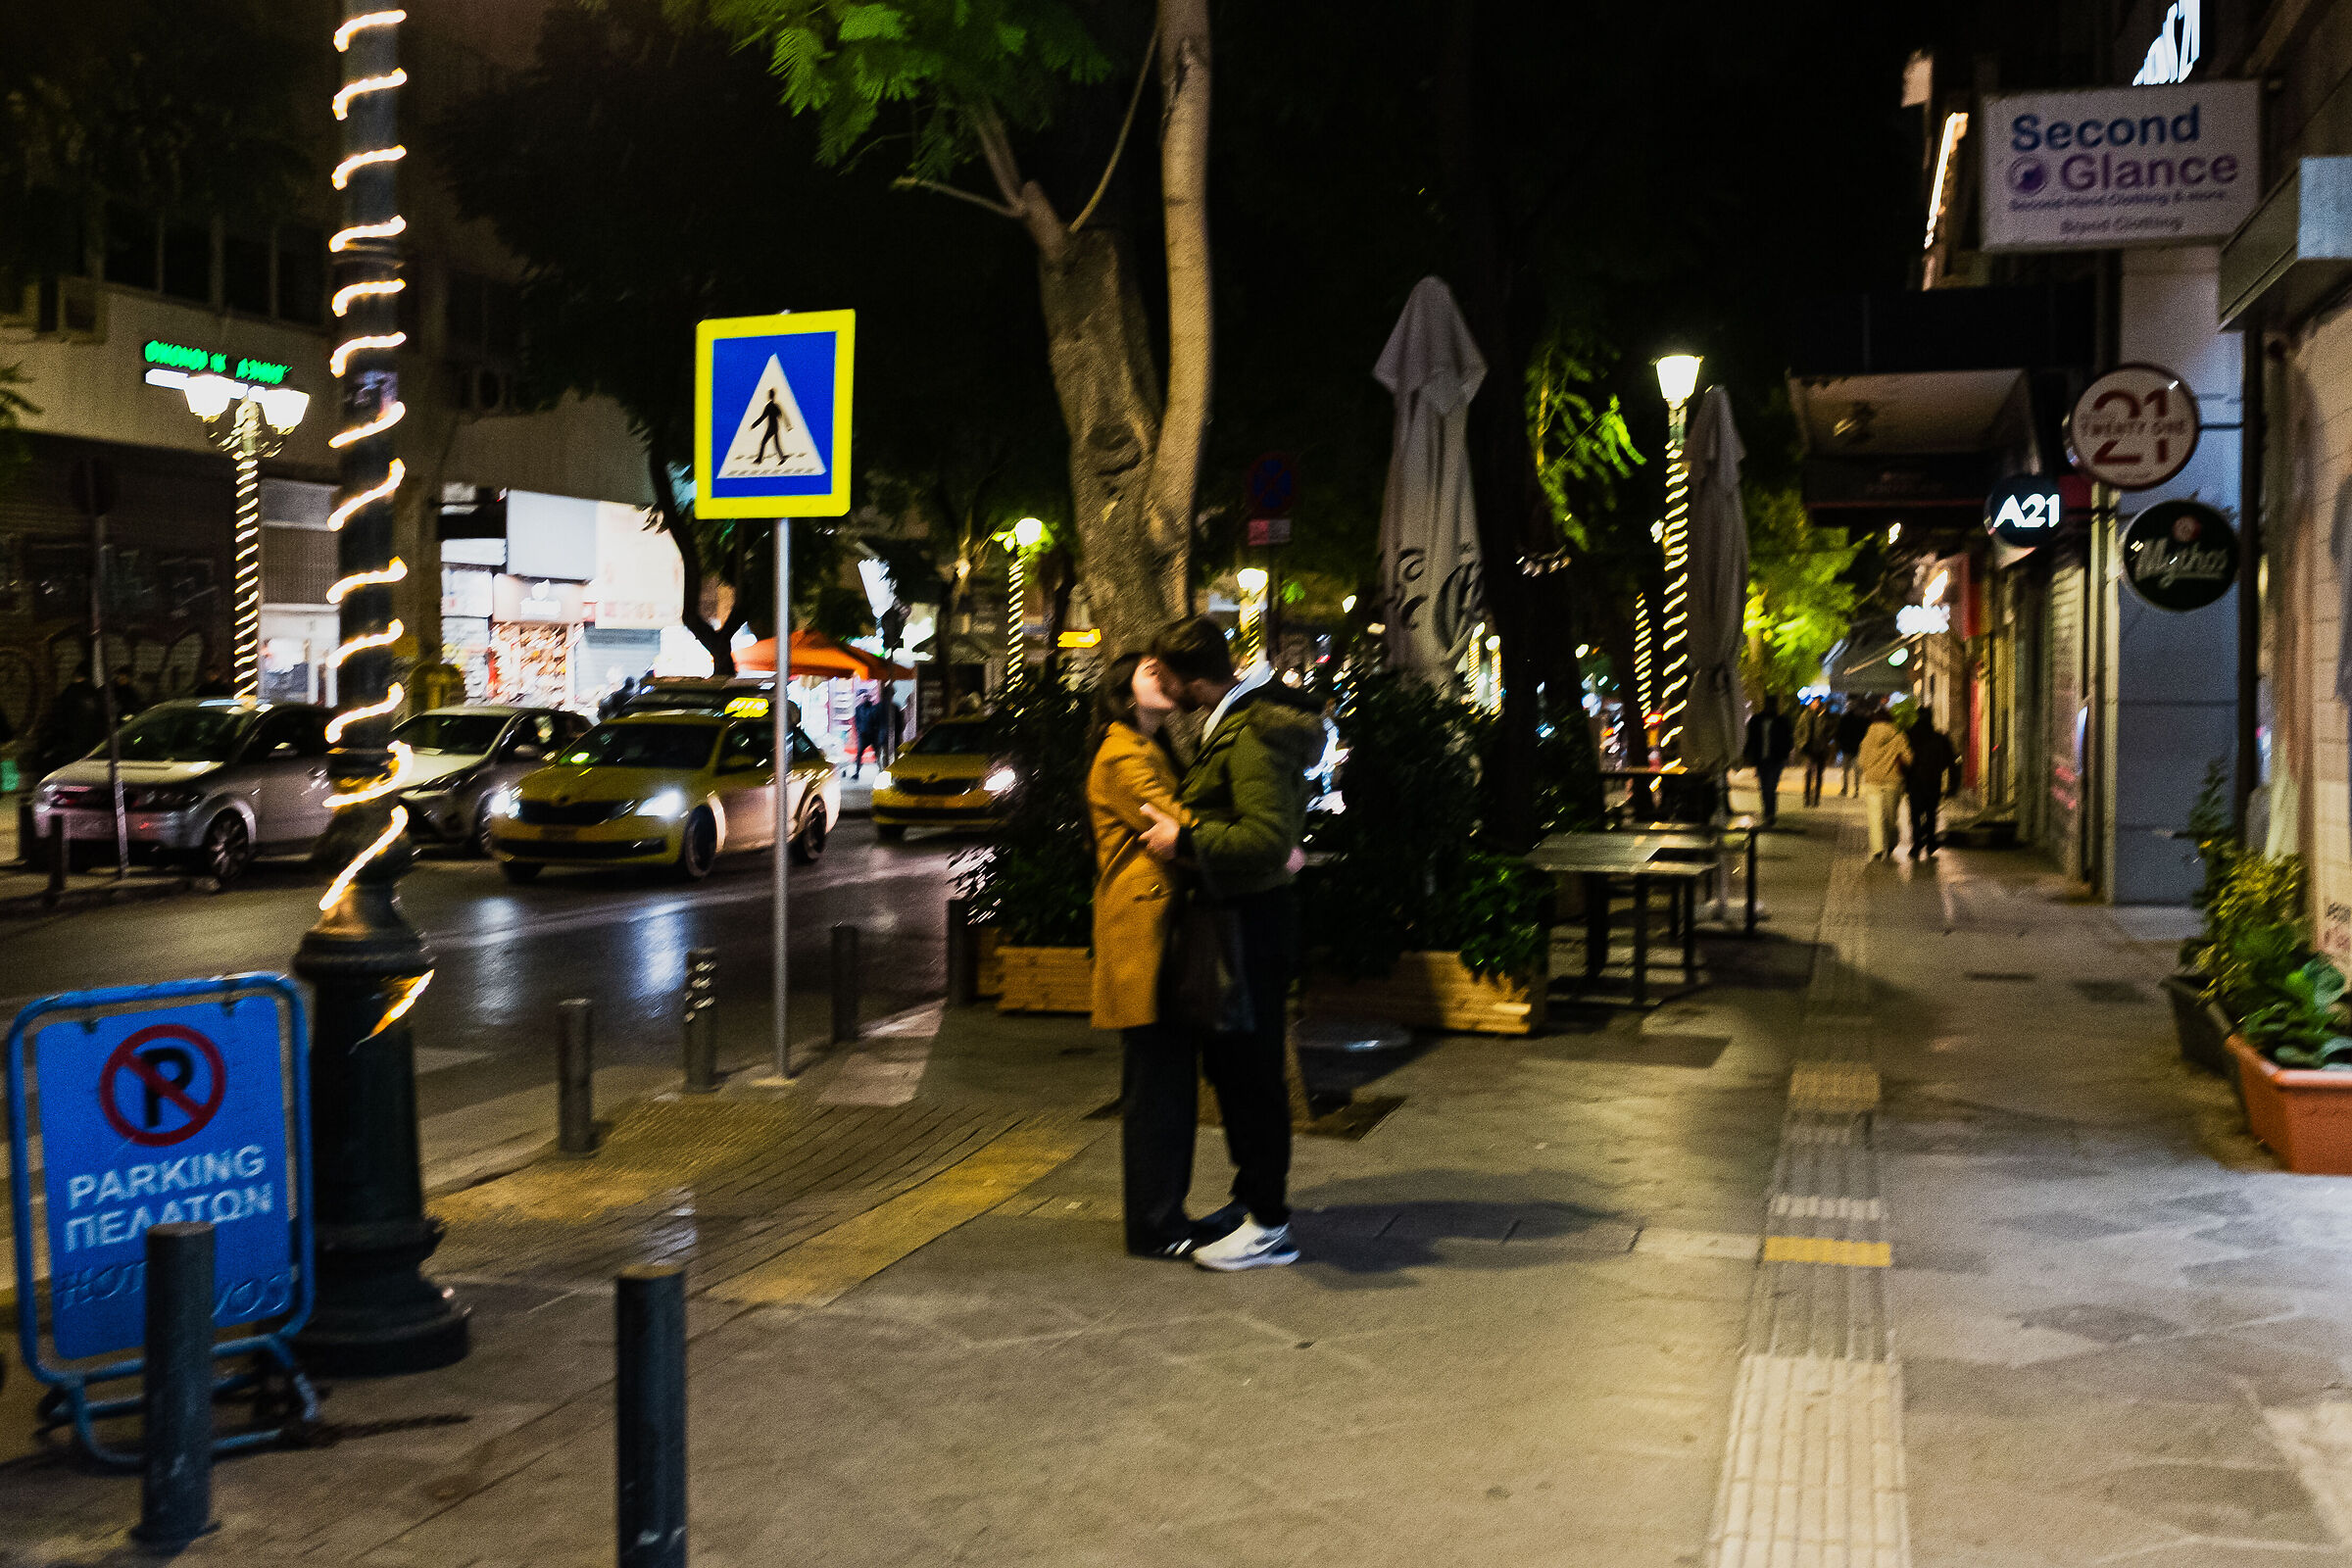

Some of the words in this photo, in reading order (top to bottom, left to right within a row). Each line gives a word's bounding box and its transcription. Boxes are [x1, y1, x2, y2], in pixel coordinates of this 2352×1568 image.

[2011, 102, 2201, 151] Second
[2061, 152, 2239, 192] Glance
[1992, 493, 2060, 528] A21
[69, 1144, 267, 1210] PARKING
